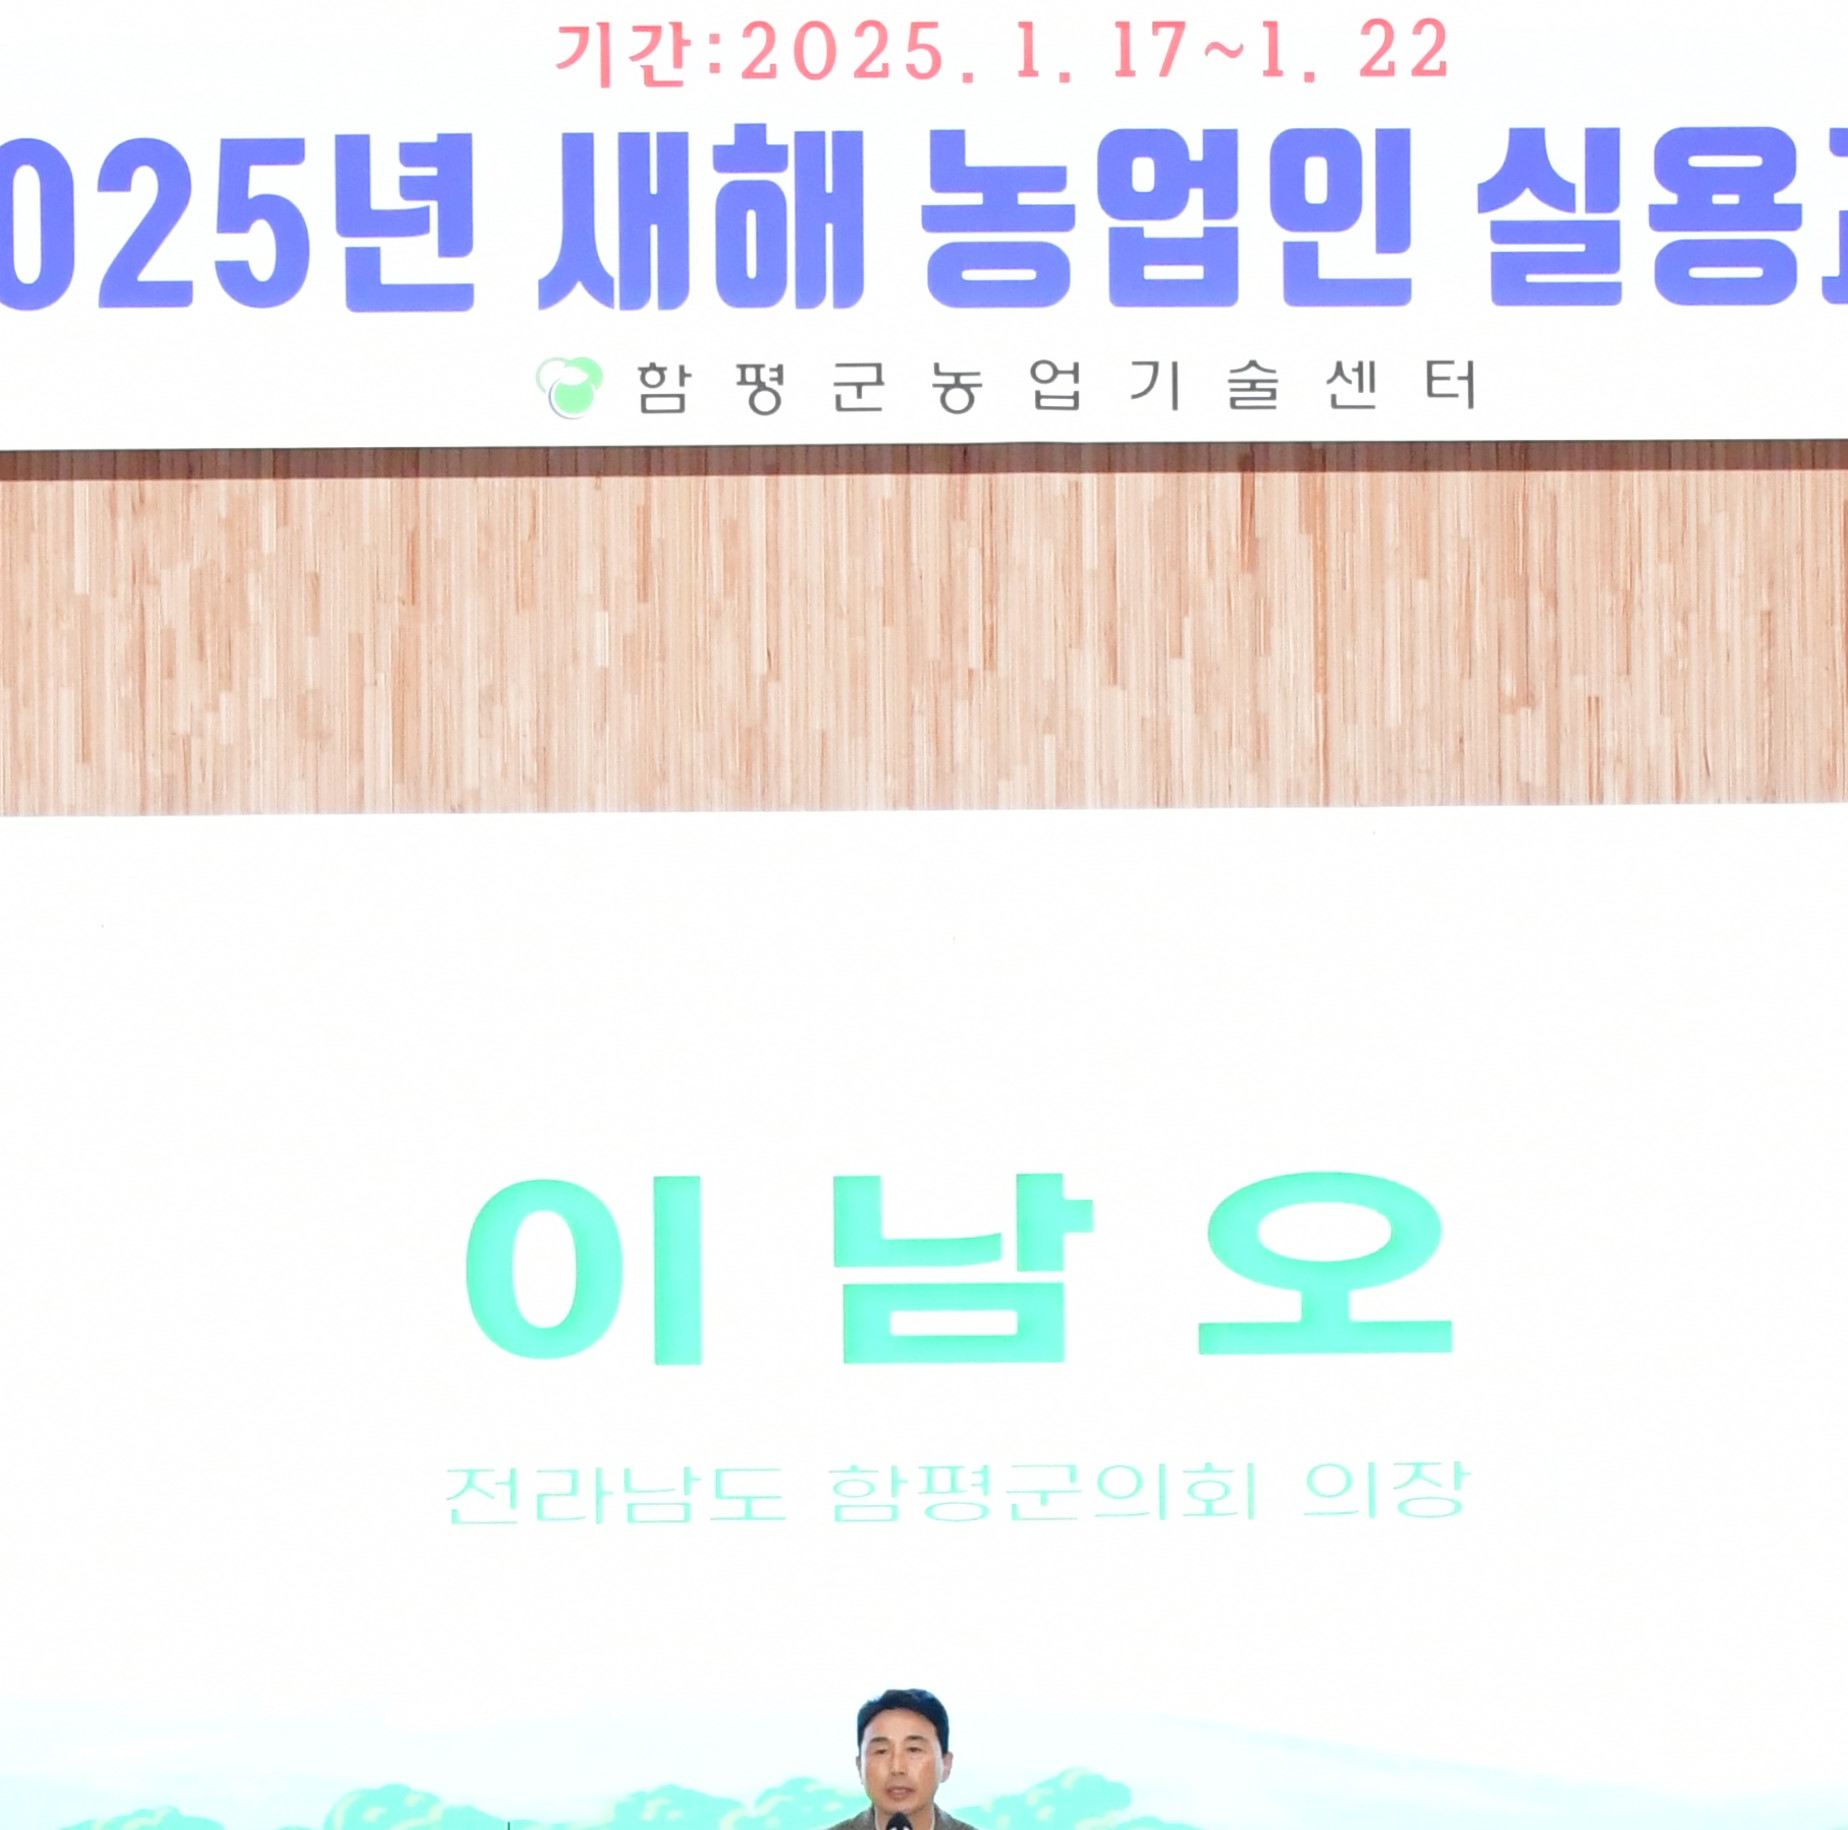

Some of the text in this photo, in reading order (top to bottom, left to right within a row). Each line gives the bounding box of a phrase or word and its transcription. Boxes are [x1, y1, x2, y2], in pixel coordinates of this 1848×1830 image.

[1018, 21, 1073, 85] 1.
[1114, 20, 1317, 85] 17~1.
[1359, 17, 1449, 79] 22
[538, 122, 867, 313] 새해
[921, 127, 1414, 311] 농업인
[637, 358, 1477, 418] 함평군농업기술센터
[445, 1458, 1474, 1527] 전라남도 함평군의회 의장
